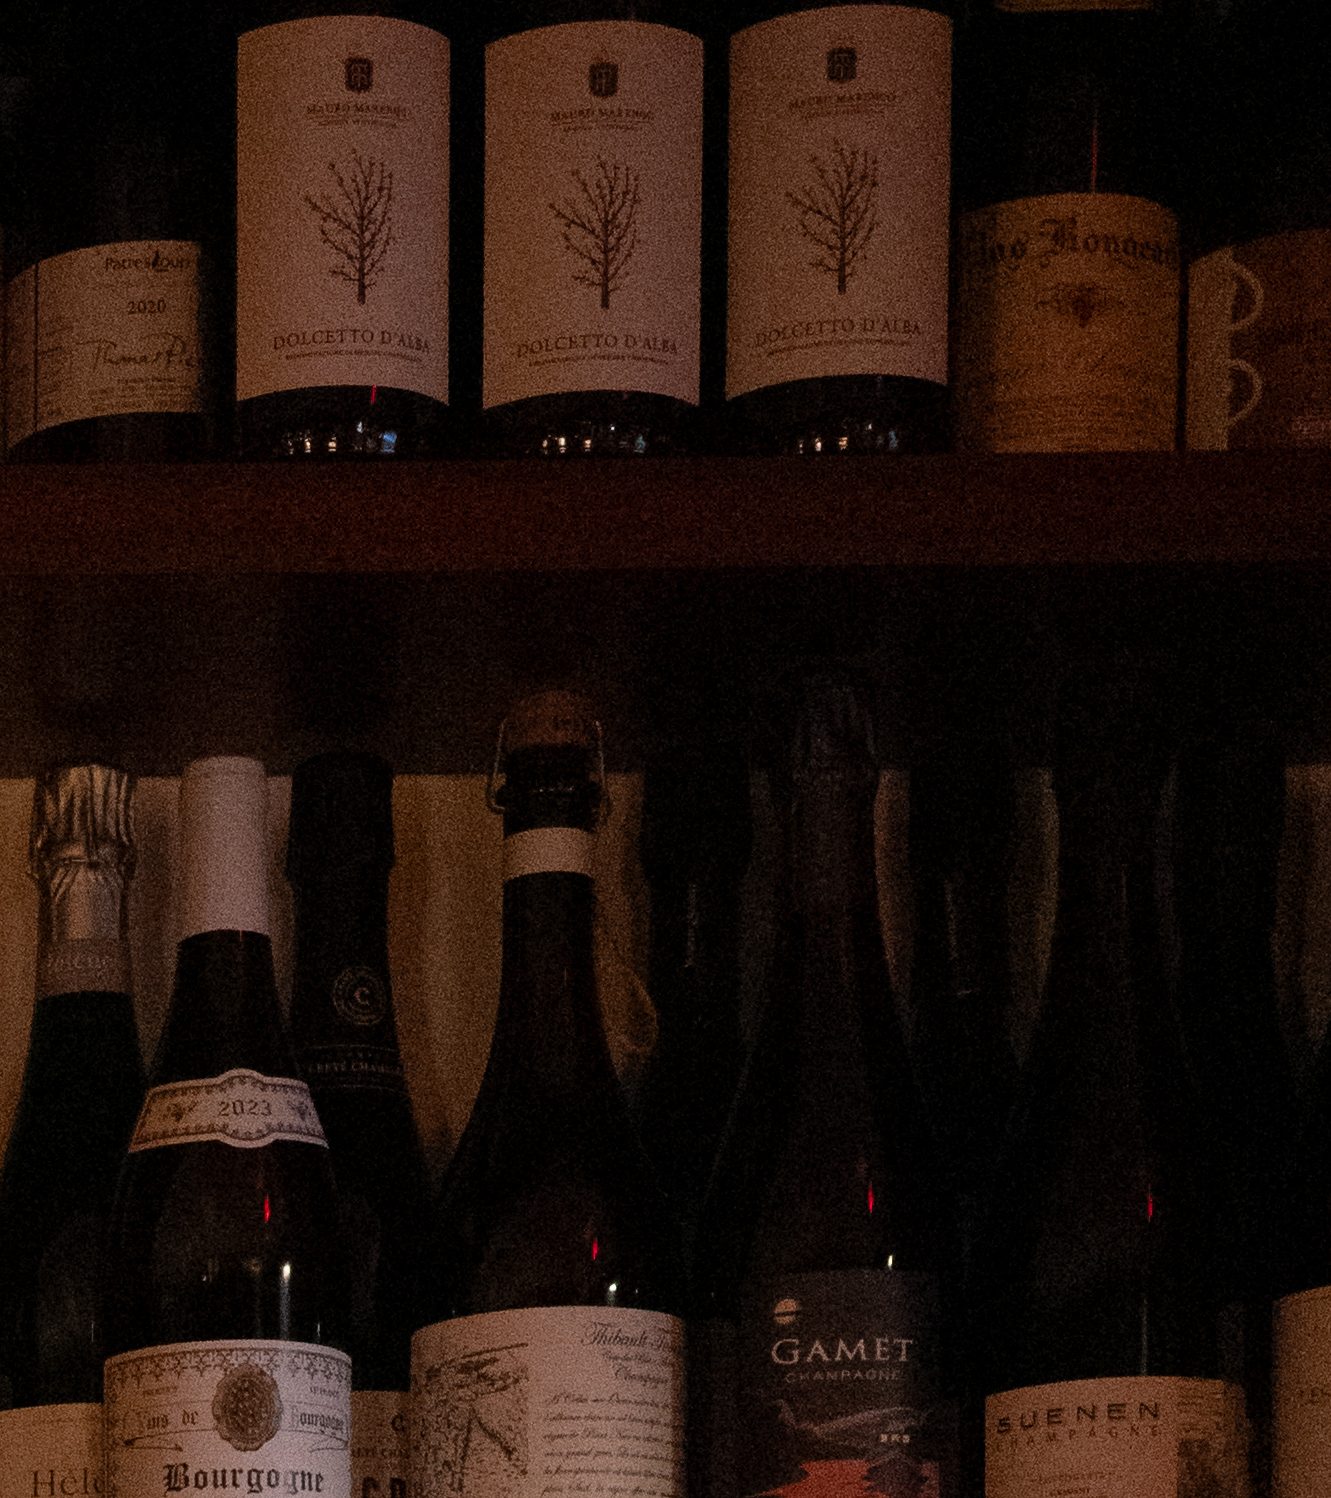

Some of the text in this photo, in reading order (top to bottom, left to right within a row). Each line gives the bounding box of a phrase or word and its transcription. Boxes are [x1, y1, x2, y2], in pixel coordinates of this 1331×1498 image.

[128, 298, 167, 315] 2020
[272, 328, 374, 350] DOLCETTO
[517, 333, 619, 358] DOLCETTO
[755, 318, 855, 348] DOLCETTO
[219, 1099, 273, 1119] 2023
[770, 1337, 914, 1365] GAMET
[784, 1370, 901, 1383] CHAMPAGNE
[996, 1402, 1159, 1434] SUENEN
[996, 1425, 1159, 1452] CHAMPAGNE
[163, 1463, 324, 1497] Bourgogne
